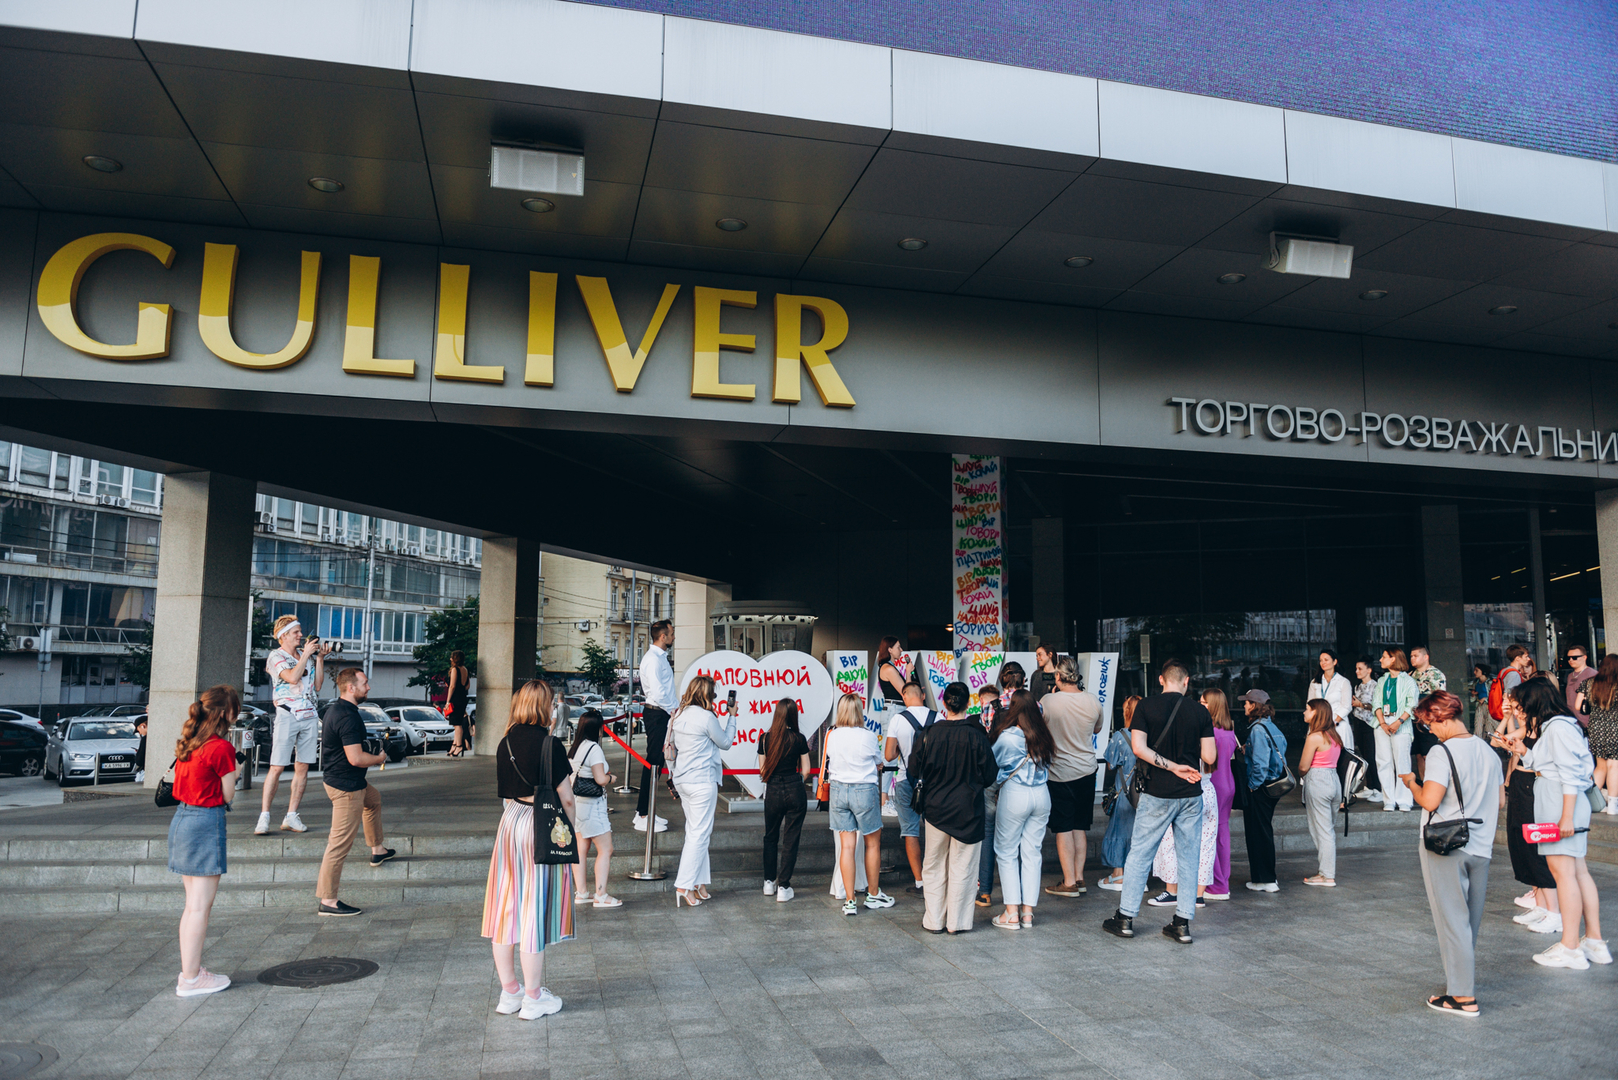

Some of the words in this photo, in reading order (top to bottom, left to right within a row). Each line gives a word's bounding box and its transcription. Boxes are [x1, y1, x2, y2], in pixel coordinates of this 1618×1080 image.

[36, 231, 856, 408] GULLIVER
[956, 475, 970, 485] ВІР
[962, 493, 998, 504] ТВОРИ
[982, 518, 996, 528] ВІР
[966, 526, 1000, 539] ГОВОРИ
[960, 537, 997, 550] КОХАЙ
[958, 572, 974, 589] ВІР
[955, 622, 999, 636] БОРИСЯ
[840, 656, 858, 668] ВІР
[936, 651, 954, 665] ВІР
[971, 654, 1003, 673] ТВОРИ
[972, 651, 993, 665] ДІЙ
[928, 655, 956, 680] ЦІЛУЙ
[970, 672, 988, 688] ВІР
